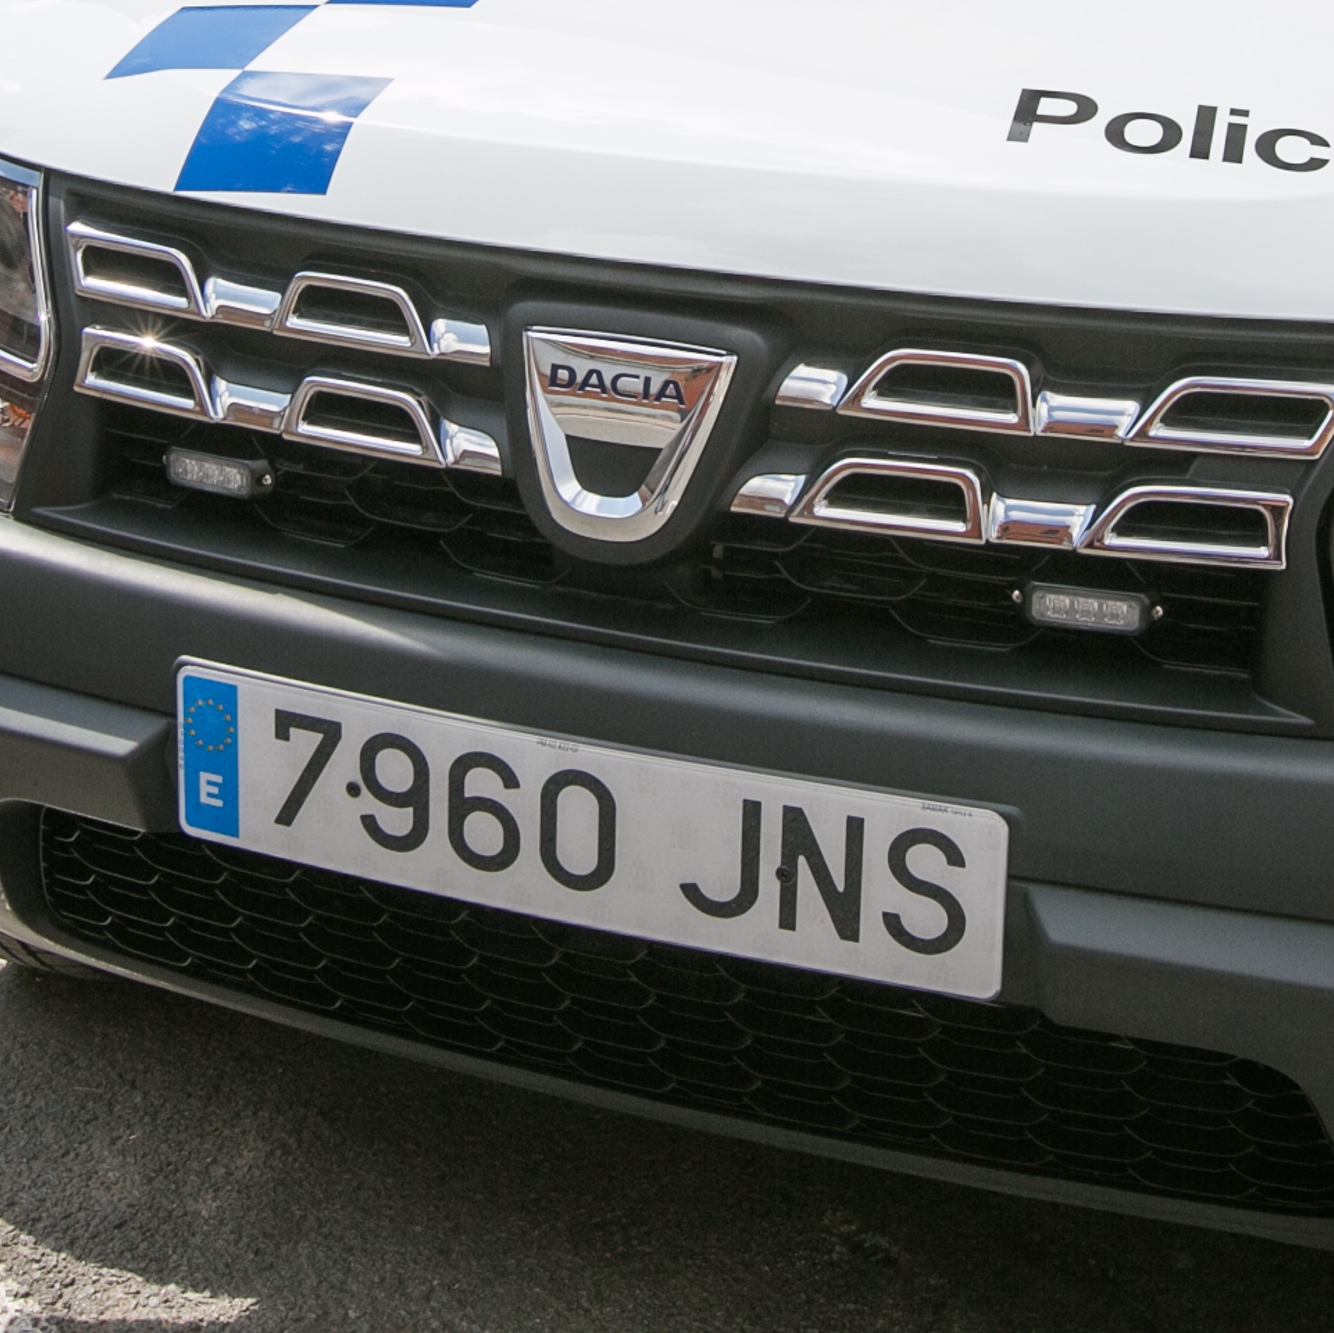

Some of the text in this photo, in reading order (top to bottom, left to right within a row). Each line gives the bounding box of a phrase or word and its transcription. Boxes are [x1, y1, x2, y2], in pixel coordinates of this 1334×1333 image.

[548, 363, 687, 406] DACIA
[199, 708, 968, 956] E 7960 JNS
